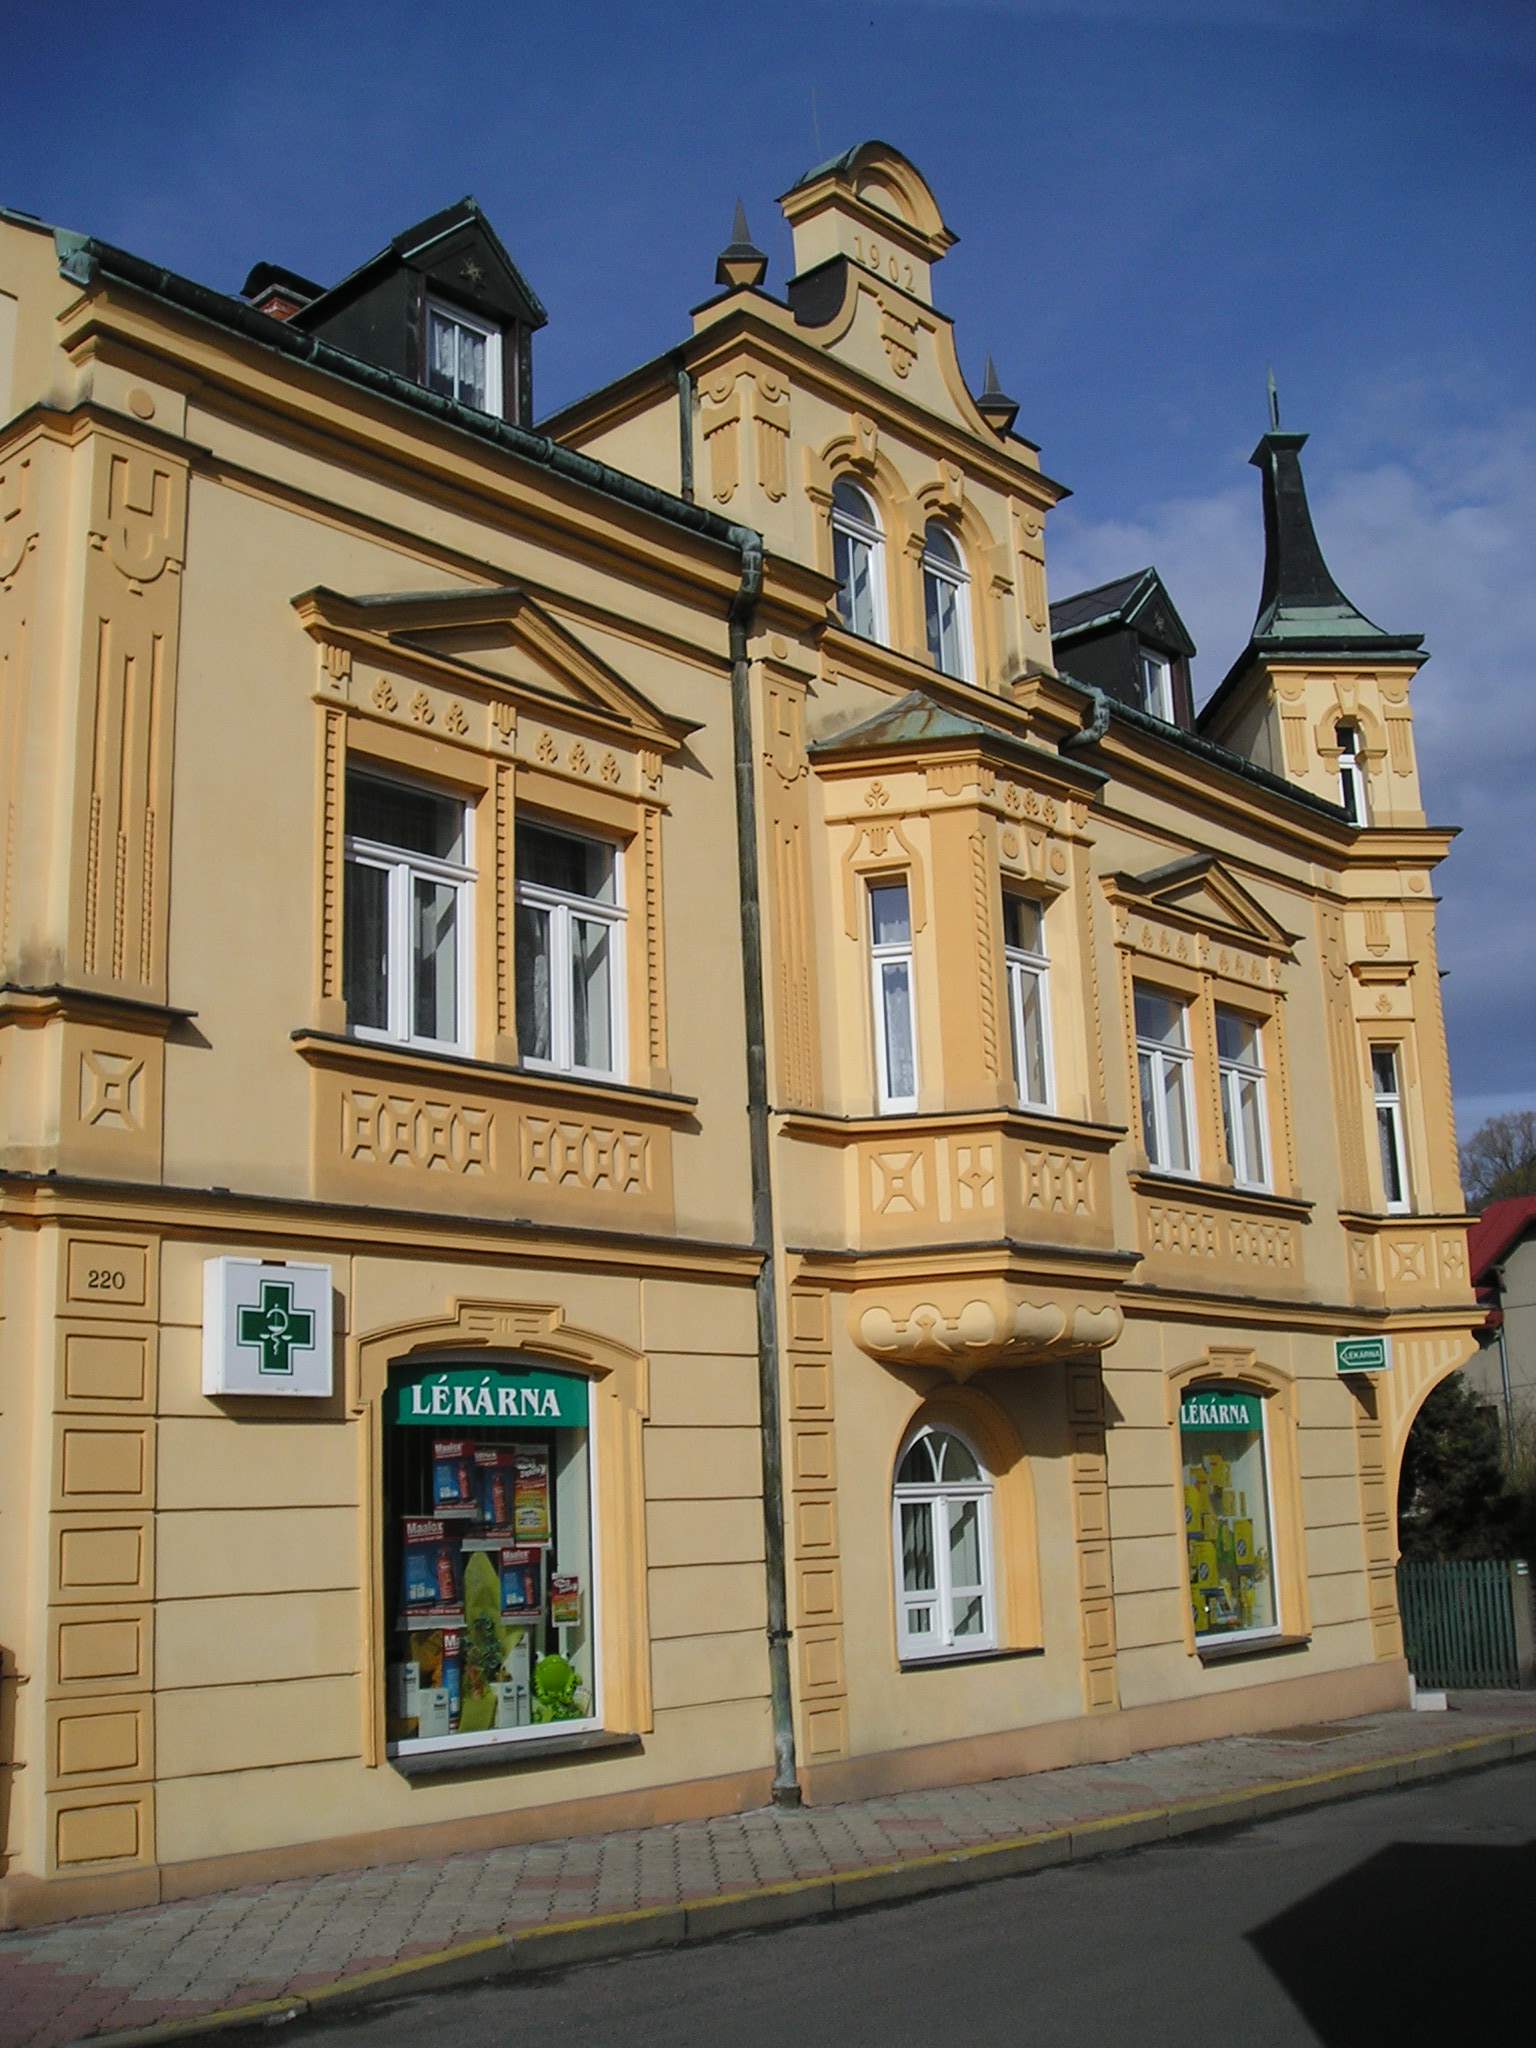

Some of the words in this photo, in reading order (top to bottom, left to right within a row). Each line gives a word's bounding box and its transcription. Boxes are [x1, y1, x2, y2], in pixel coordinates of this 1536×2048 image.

[854, 235, 915, 293] 1902
[88, 1270, 125, 1290] 220
[412, 1375, 562, 1416] LÉKÁRNA
[1181, 1397, 1250, 1424] LÉKÁRNA
[407, 1521, 444, 1534] Maalox
